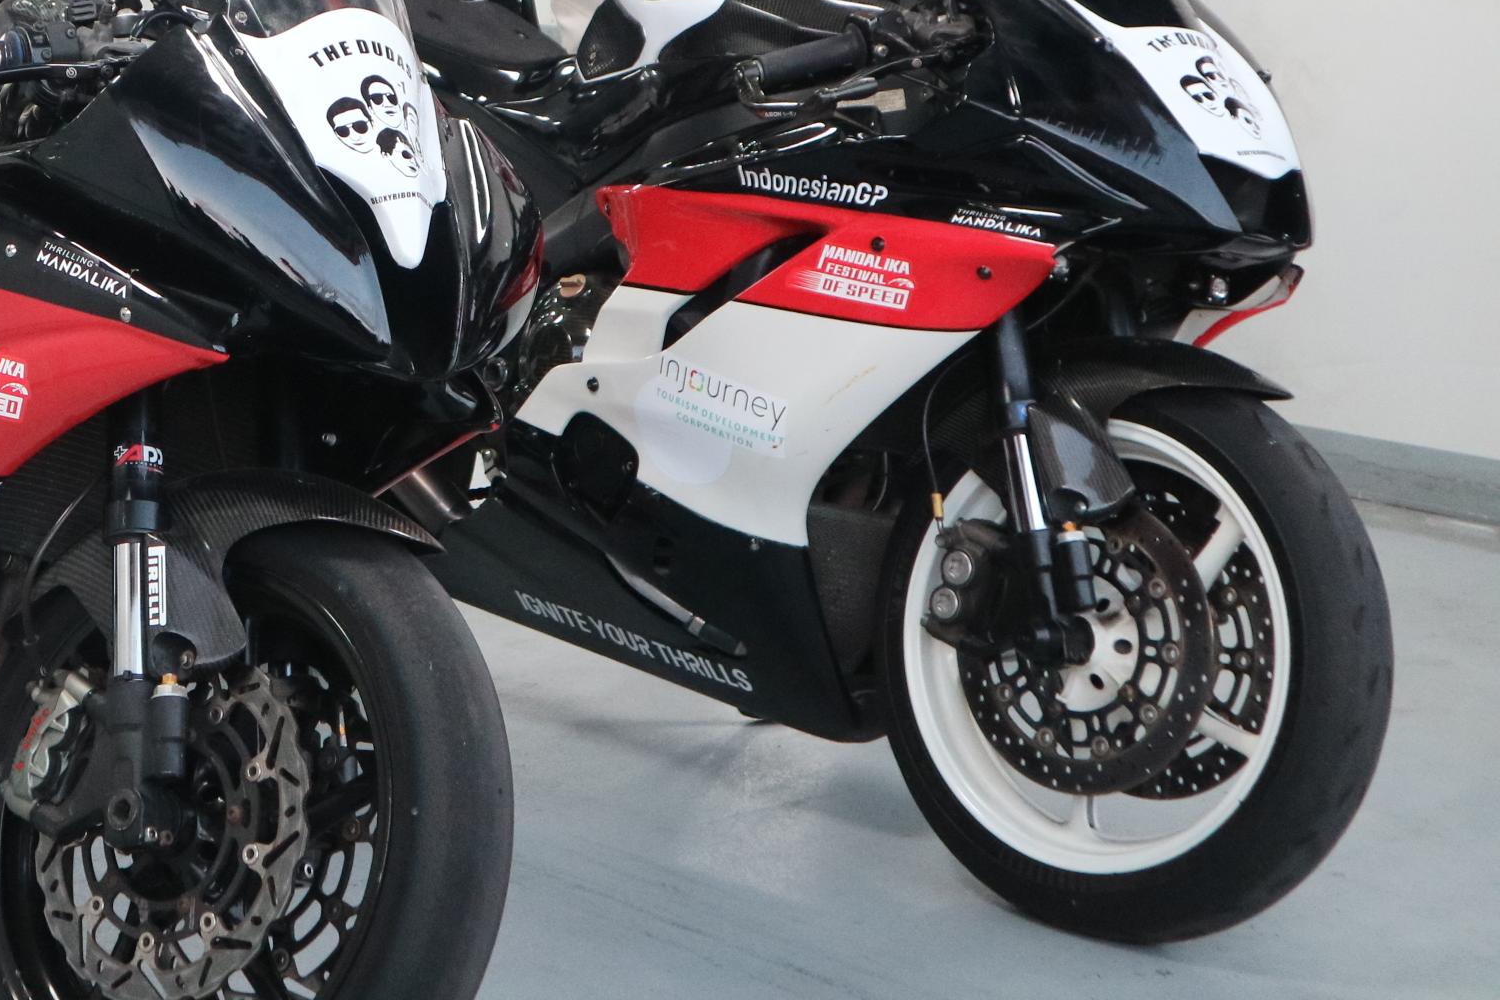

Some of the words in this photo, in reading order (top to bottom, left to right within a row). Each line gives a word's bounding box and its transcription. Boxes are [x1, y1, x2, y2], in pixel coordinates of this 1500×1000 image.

[308, 40, 353, 68] THE
[355, 39, 412, 81] DUDAS
[737, 164, 889, 208] IndonesianGP
[951, 214, 1041, 238] MANDALIKA
[957, 208, 1007, 221] THRILLING
[43, 240, 94, 268] THRILLING
[816, 244, 911, 275] MANDALIKA
[825, 262, 887, 285] FESTIVAL
[36, 250, 128, 298] MANDALIKA
[822, 277, 844, 293] OF
[846, 281, 906, 305] SPEED
[659, 356, 787, 432] injourney
[656, 387, 699, 412] TOURISM
[701, 408, 785, 445] DEVELOPMENT
[676, 412, 754, 449] CORPORATION
[148, 545, 167, 627] PIRELLI
[514, 590, 592, 634] IGNITE
[587, 618, 656, 659] YOUR
[650, 641, 754, 692] THRILLS
